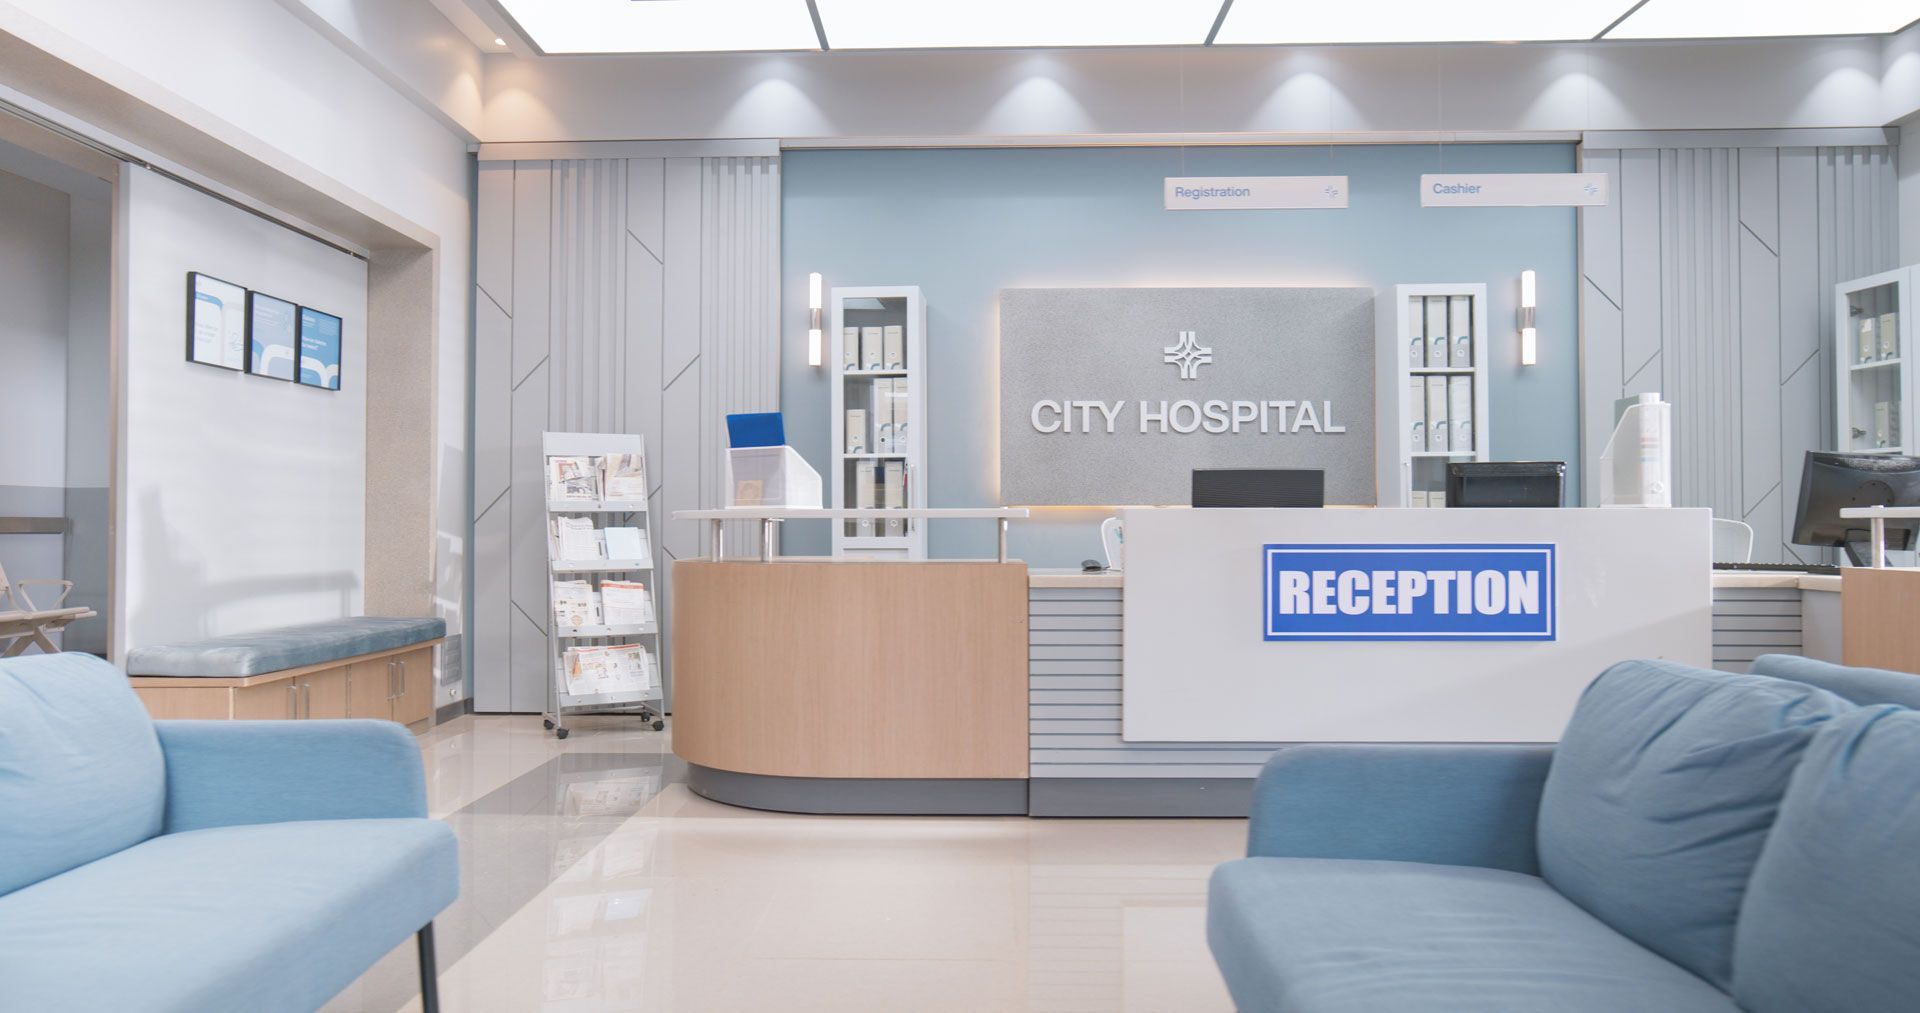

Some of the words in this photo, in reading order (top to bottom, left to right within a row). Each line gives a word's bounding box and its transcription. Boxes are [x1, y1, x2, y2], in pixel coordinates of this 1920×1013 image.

[1175, 186, 1250, 201] Registration
[1433, 183, 1481, 195] Cashier
[1031, 399, 1125, 433] CITY
[1140, 399, 1346, 433] HOSPITAL
[1279, 570, 1539, 615] RECEPTION
